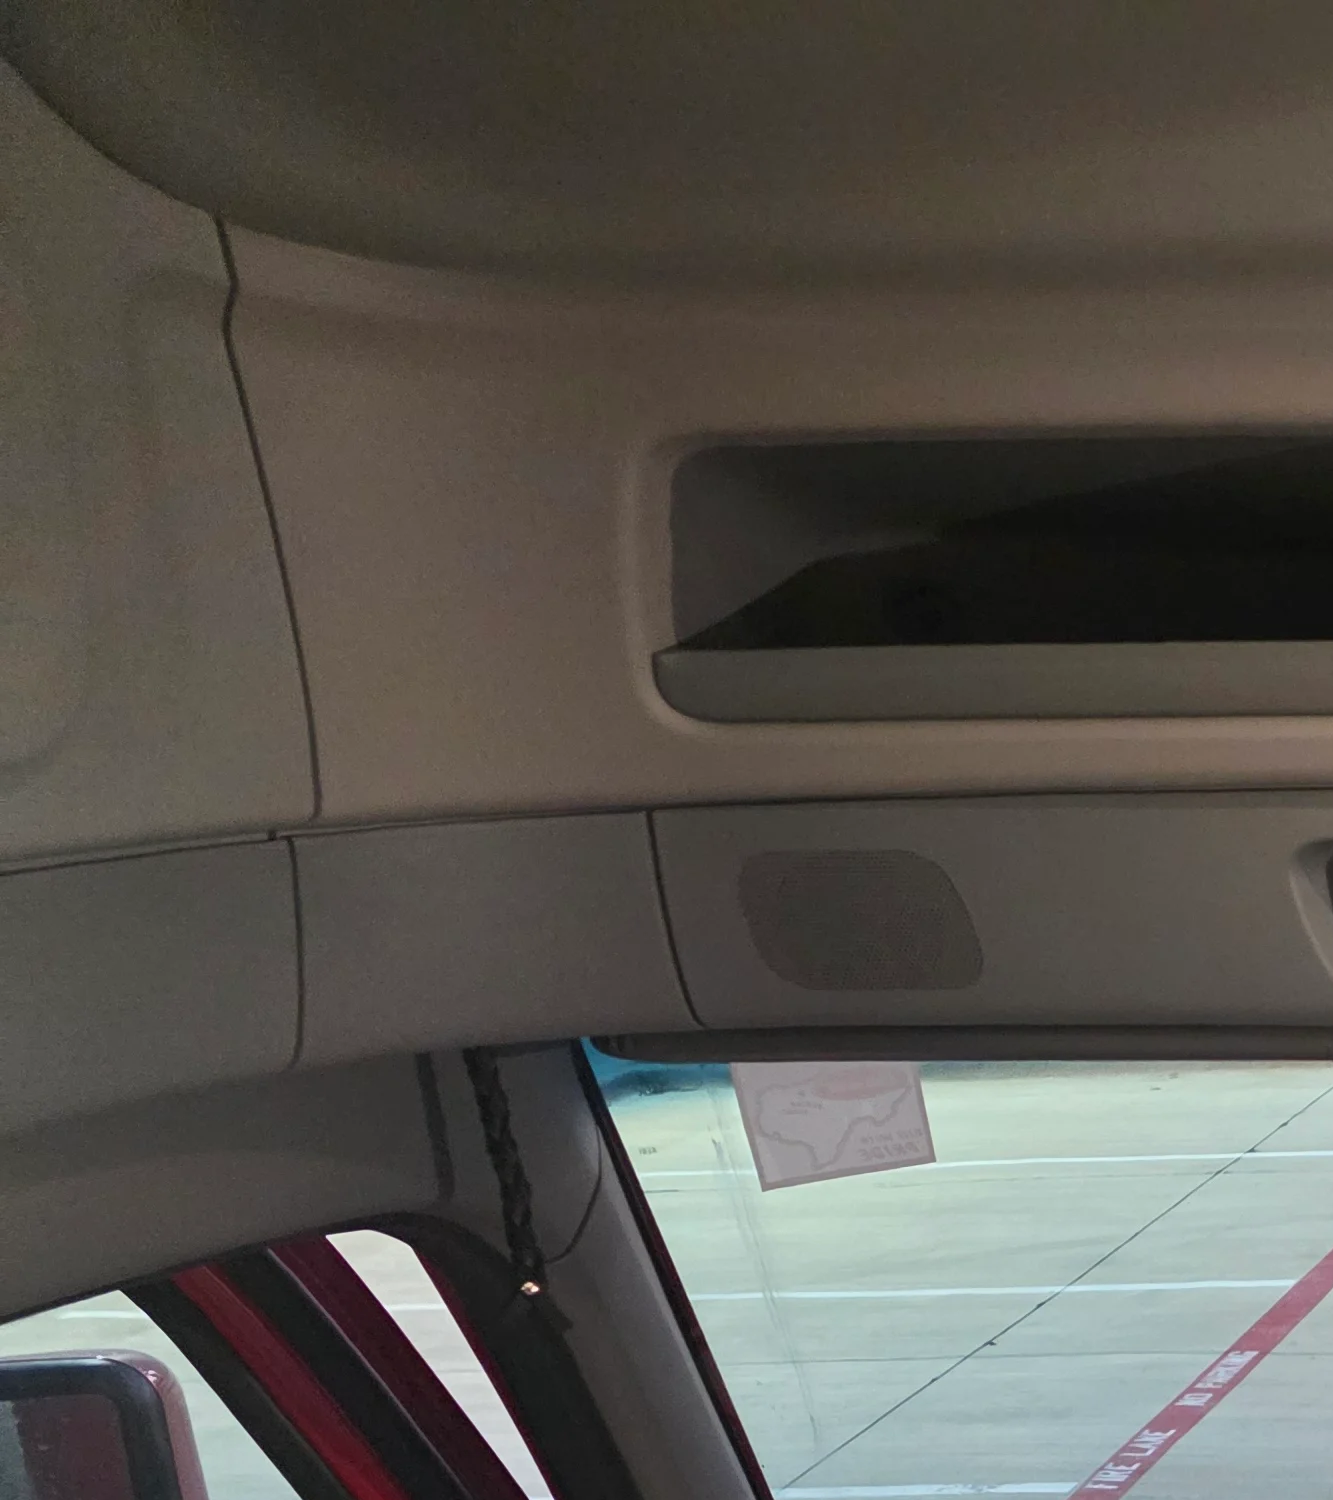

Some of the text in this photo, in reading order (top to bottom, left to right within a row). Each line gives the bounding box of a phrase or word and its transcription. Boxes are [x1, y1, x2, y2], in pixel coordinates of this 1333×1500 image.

[1084, 1462, 1141, 1489] FIRE
[1119, 1429, 1176, 1457] LANE
[1174, 1393, 1213, 1406] NO
